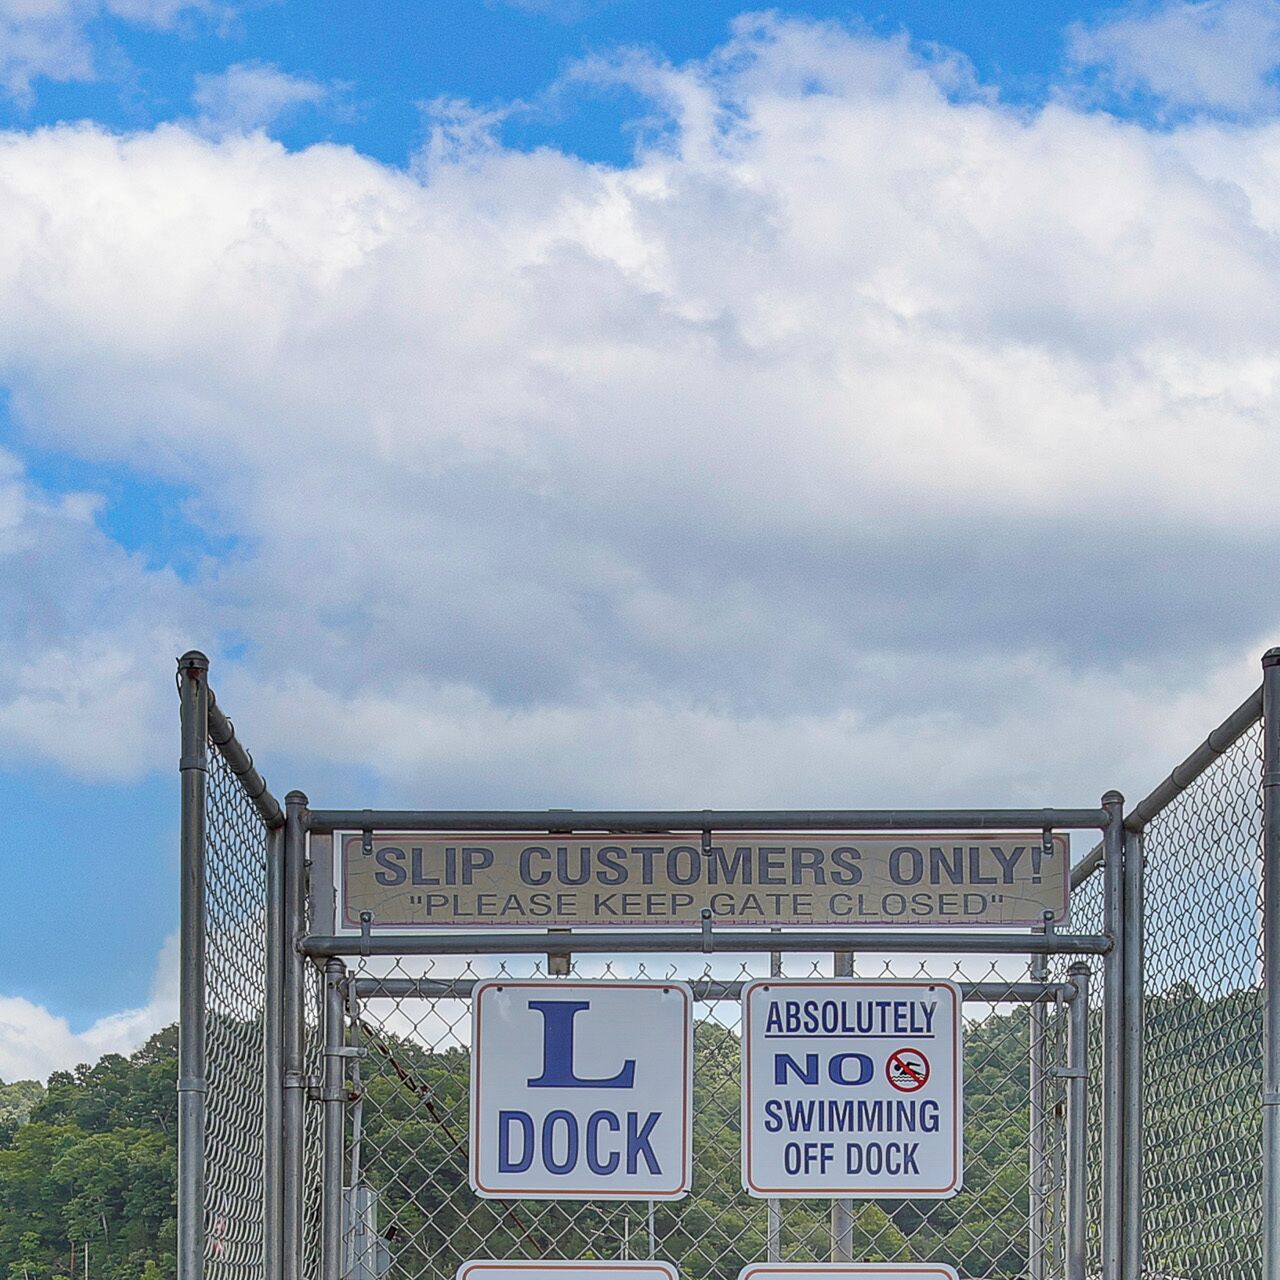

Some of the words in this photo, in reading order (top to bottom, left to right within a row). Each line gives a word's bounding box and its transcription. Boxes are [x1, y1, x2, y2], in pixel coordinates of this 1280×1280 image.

[375, 846, 494, 886] SLIP
[520, 846, 864, 886] CUSTOMERS
[889, 846, 1043, 886] ONLY!
[410, 893, 583, 917] "PLEASE
[595, 894, 693, 915] KEEP
[712, 893, 818, 917] GATE
[829, 892, 1004, 916] CLOSED"
[766, 1001, 937, 1033] ABSOLUTELY
[527, 1000, 636, 1089] L
[775, 1053, 874, 1085] NO
[765, 1100, 939, 1132] SWIMMING
[498, 1110, 662, 1175] DOCK
[785, 1142, 834, 1175] OFF
[847, 1142, 919, 1175] DOCK
